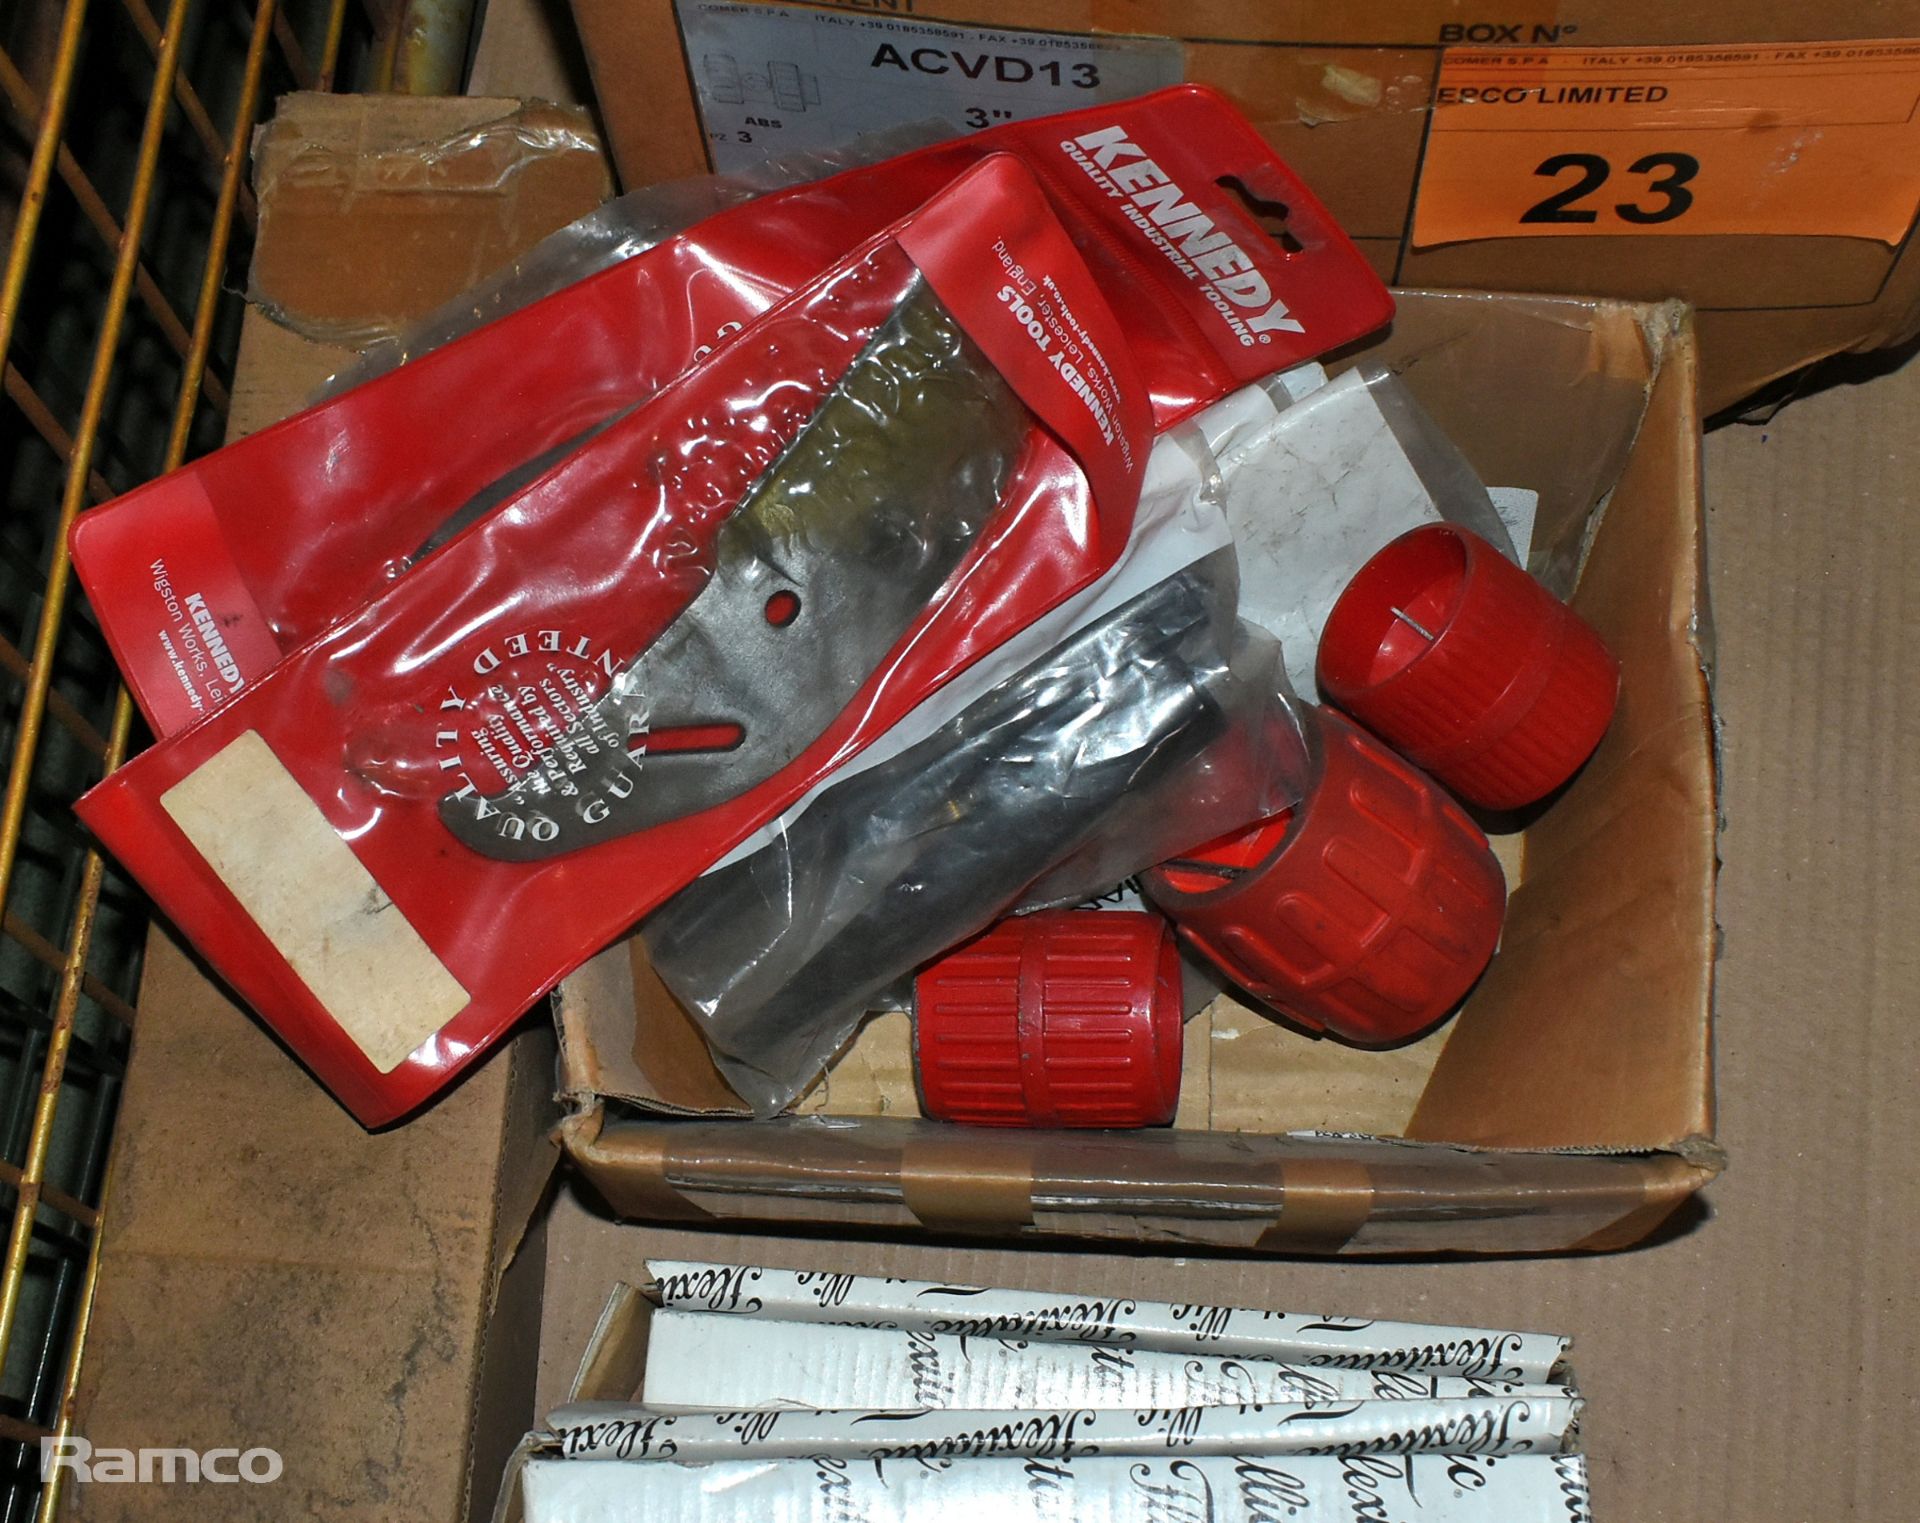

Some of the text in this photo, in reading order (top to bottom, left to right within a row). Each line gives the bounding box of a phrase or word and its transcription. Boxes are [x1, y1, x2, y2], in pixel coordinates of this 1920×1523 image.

[815, 15, 855, 27] ITALY
[860, 20, 883, 30] +39
[978, 33, 1008, 43] FAX
[1011, 37, 1036, 47] +39
[871, 42, 1101, 90] ACVD13
[1438, 23, 1522, 43] BOX
[1443, 56, 1502, 65] COMER
[1582, 56, 1629, 65] ITALY
[1635, 56, 1662, 64] +39
[1775, 51, 1808, 60] FAX
[1814, 50, 1842, 58] +39
[745, 116, 783, 129] ABS
[1436, 86, 1668, 105] EPCO LIMITED
[737, 131, 753, 144] 3
[1518, 152, 1701, 225] 23
[1059, 140, 1255, 347] QUALITY INDUSTRIAL TOOLING
[1074, 125, 1306, 334] KENNEDY
[991, 235, 1134, 474] Wigston Works, Leicester, England.
[996, 285, 1115, 447] KENNEDY TOOLS
[150, 558, 226, 705] Wigston Works, Lei
[183, 592, 246, 694] KENNEDY
[435, 629, 650, 843] QUALITY GUARANTEED
[487, 684, 579, 797] & Performance
[487, 713, 552, 796] the Quality
[517, 686, 588, 775] Required by
[539, 677, 601, 755] all Sectors
[597, 731, 620, 749] of
